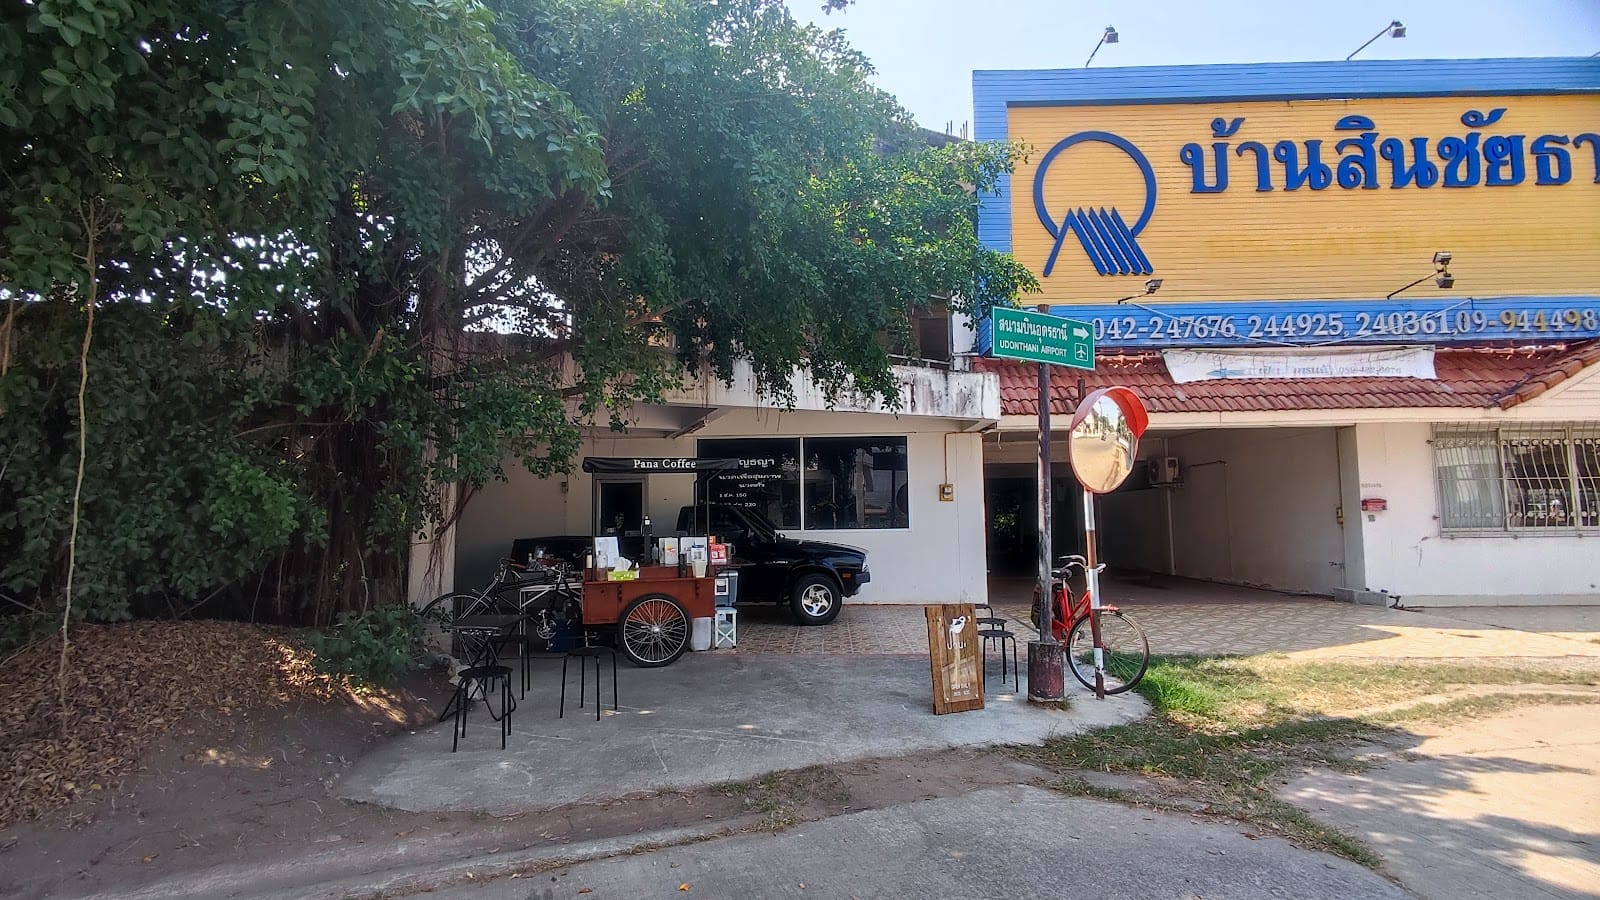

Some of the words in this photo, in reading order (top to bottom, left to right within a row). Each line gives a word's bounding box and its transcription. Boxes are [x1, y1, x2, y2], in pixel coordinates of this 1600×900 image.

[999, 317, 1067, 343] สนามบินอุดรธานี
[1000, 340, 1039, 353] UDONTHANI
[1041, 345, 1067, 358] AIRPORT
[634, 459, 658, 468] Pana
[662, 459, 696, 468] Coffee
